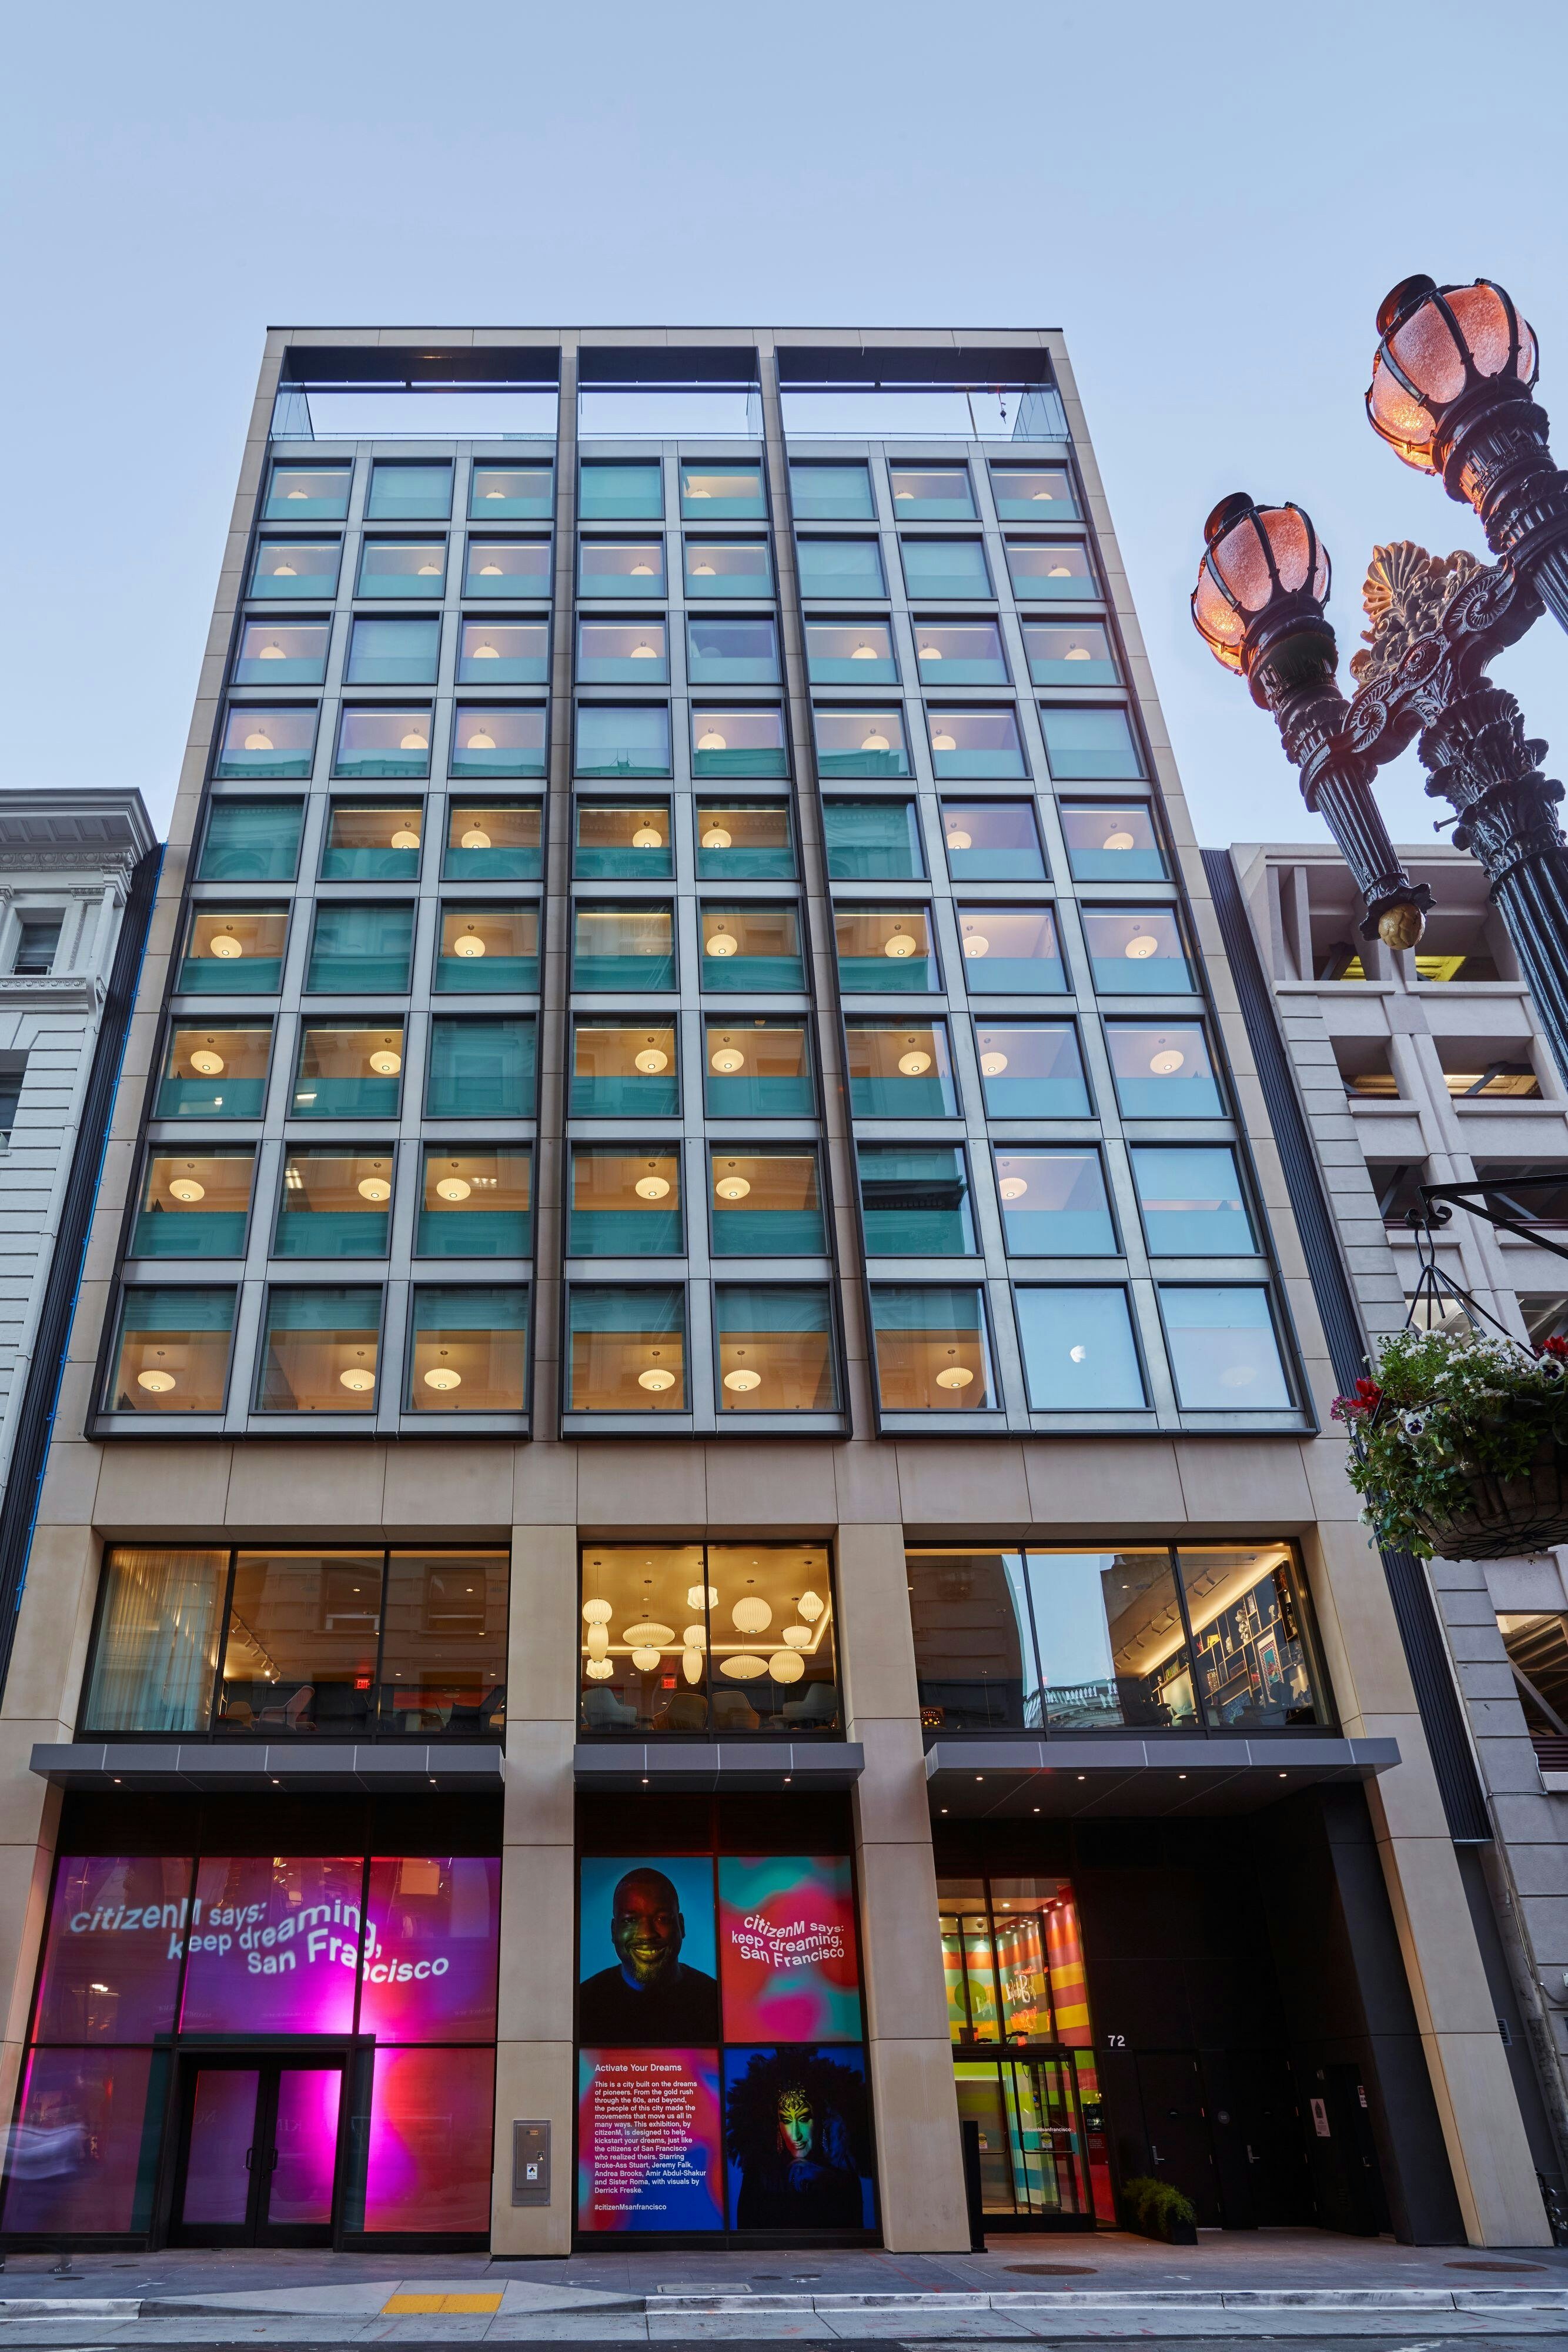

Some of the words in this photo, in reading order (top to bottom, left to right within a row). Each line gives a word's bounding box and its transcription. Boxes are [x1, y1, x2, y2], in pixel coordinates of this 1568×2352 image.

[357, 1680, 369, 1688] EXIT
[70, 1898, 202, 1933] citizenM
[209, 1902, 268, 1932] says:
[744, 1915, 805, 1937] citizenM
[810, 1923, 844, 1935] says:
[168, 1933, 232, 1960] keep
[239, 1899, 382, 1959] dreaming,
[732, 1930, 764, 1949] keep
[769, 1933, 842, 1952] dreaming,
[248, 1950, 296, 1974] San
[307, 1929, 449, 1983] Francisco
[741, 1946, 770, 1964] San
[774, 1947, 844, 1967] Francisco
[1108, 2035, 1125, 2047] 72
[691, 2178, 699, 2186] by
